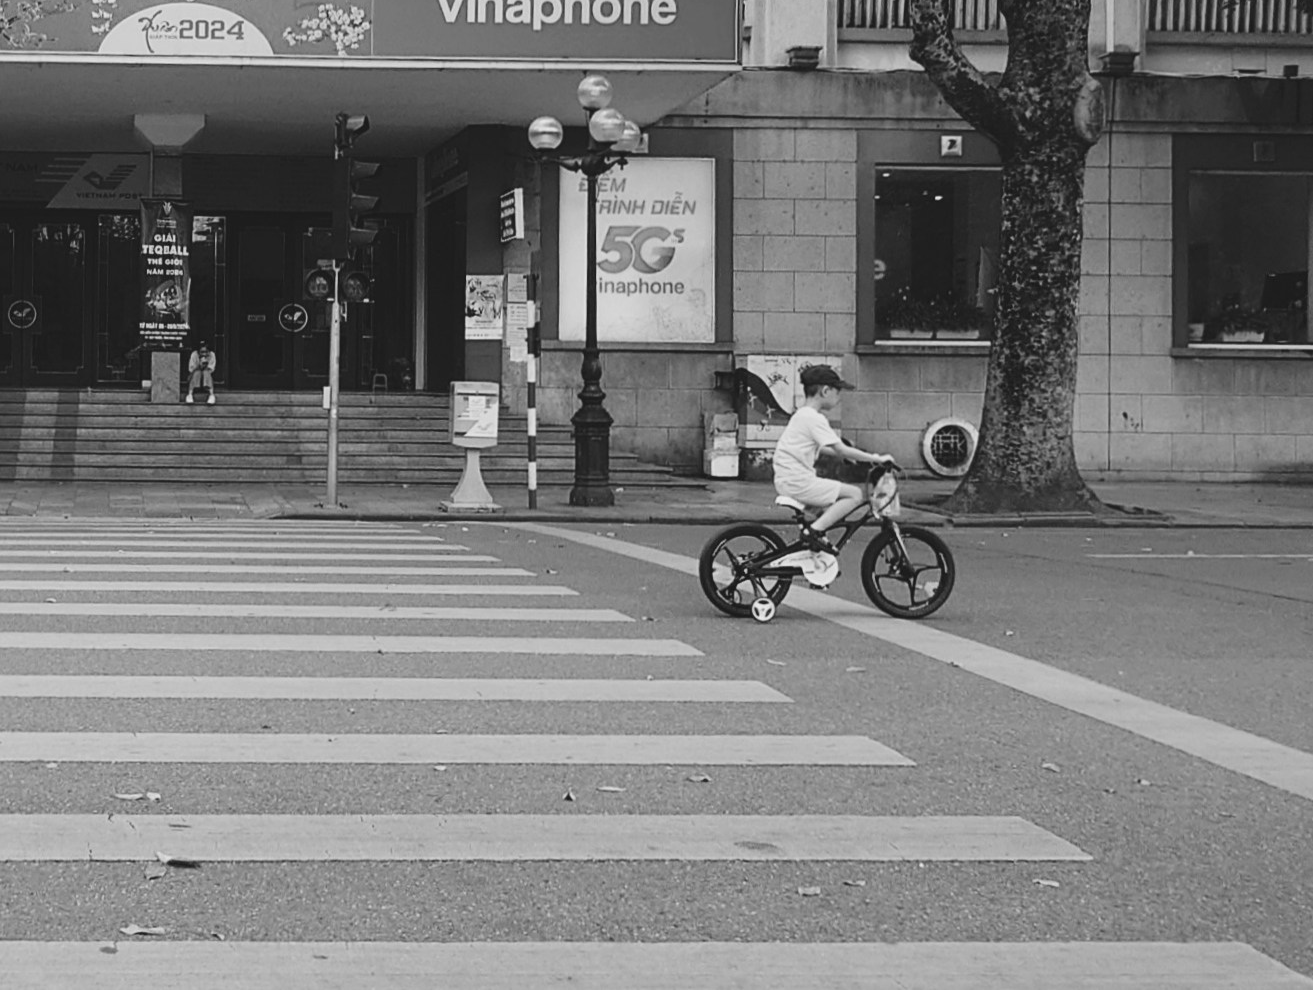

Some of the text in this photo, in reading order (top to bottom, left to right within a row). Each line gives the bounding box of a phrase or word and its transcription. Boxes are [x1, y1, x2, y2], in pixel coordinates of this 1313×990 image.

[179, 19, 244, 40] 2024
[6, 162, 39, 173] NAM
[76, 192, 116, 200] VIETNAM
[596, 191, 696, 215] RÌNH DIỄN
[142, 244, 189, 256] TEQBALL
[596, 277, 685, 297] inaphone
